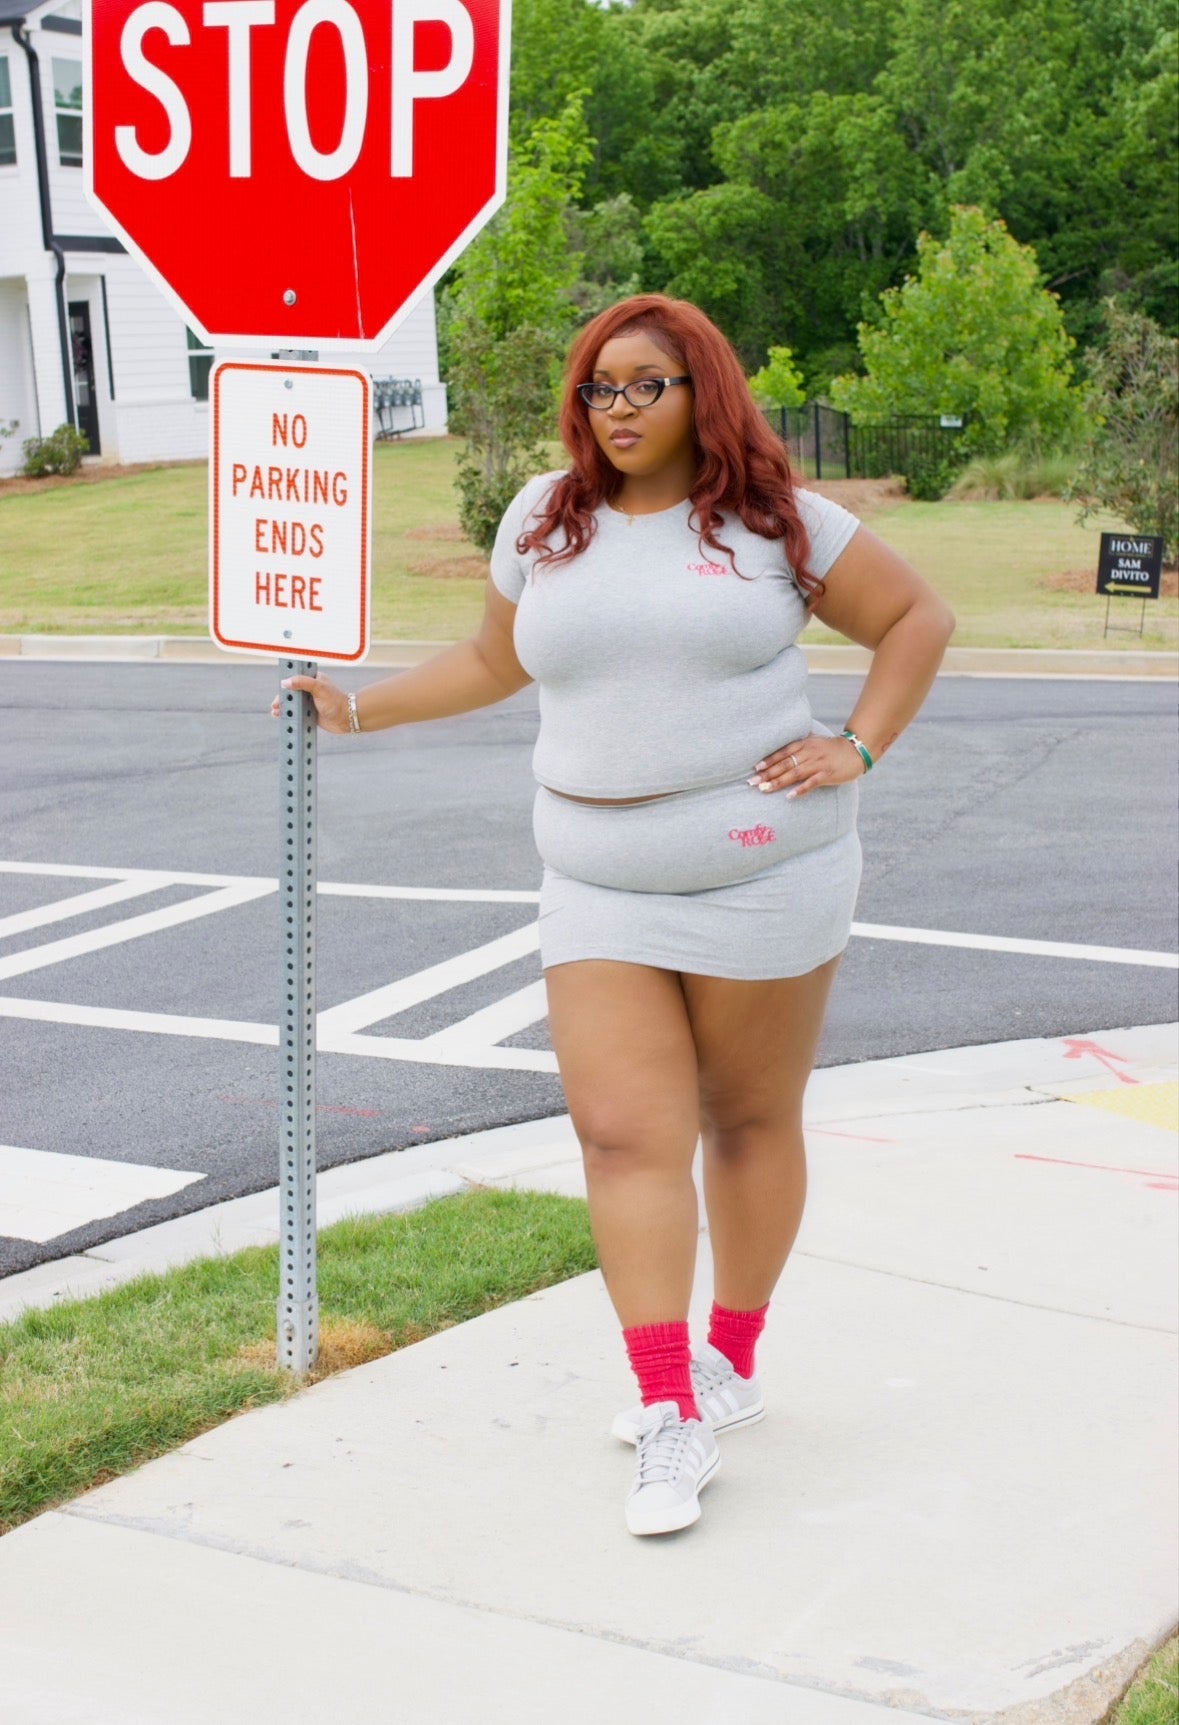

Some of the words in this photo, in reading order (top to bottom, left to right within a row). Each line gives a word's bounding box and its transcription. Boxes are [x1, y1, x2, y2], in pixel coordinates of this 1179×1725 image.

[115, 0, 474, 181] STOP
[272, 413, 307, 448] NO
[232, 463, 348, 506] PARKING
[255, 518, 324, 558] ENDS
[1111, 540, 1152, 554] HOME
[1110, 569, 1149, 581] DIVITO
[1118, 558, 1141, 569] SAM
[255, 571, 323, 612] HERE
